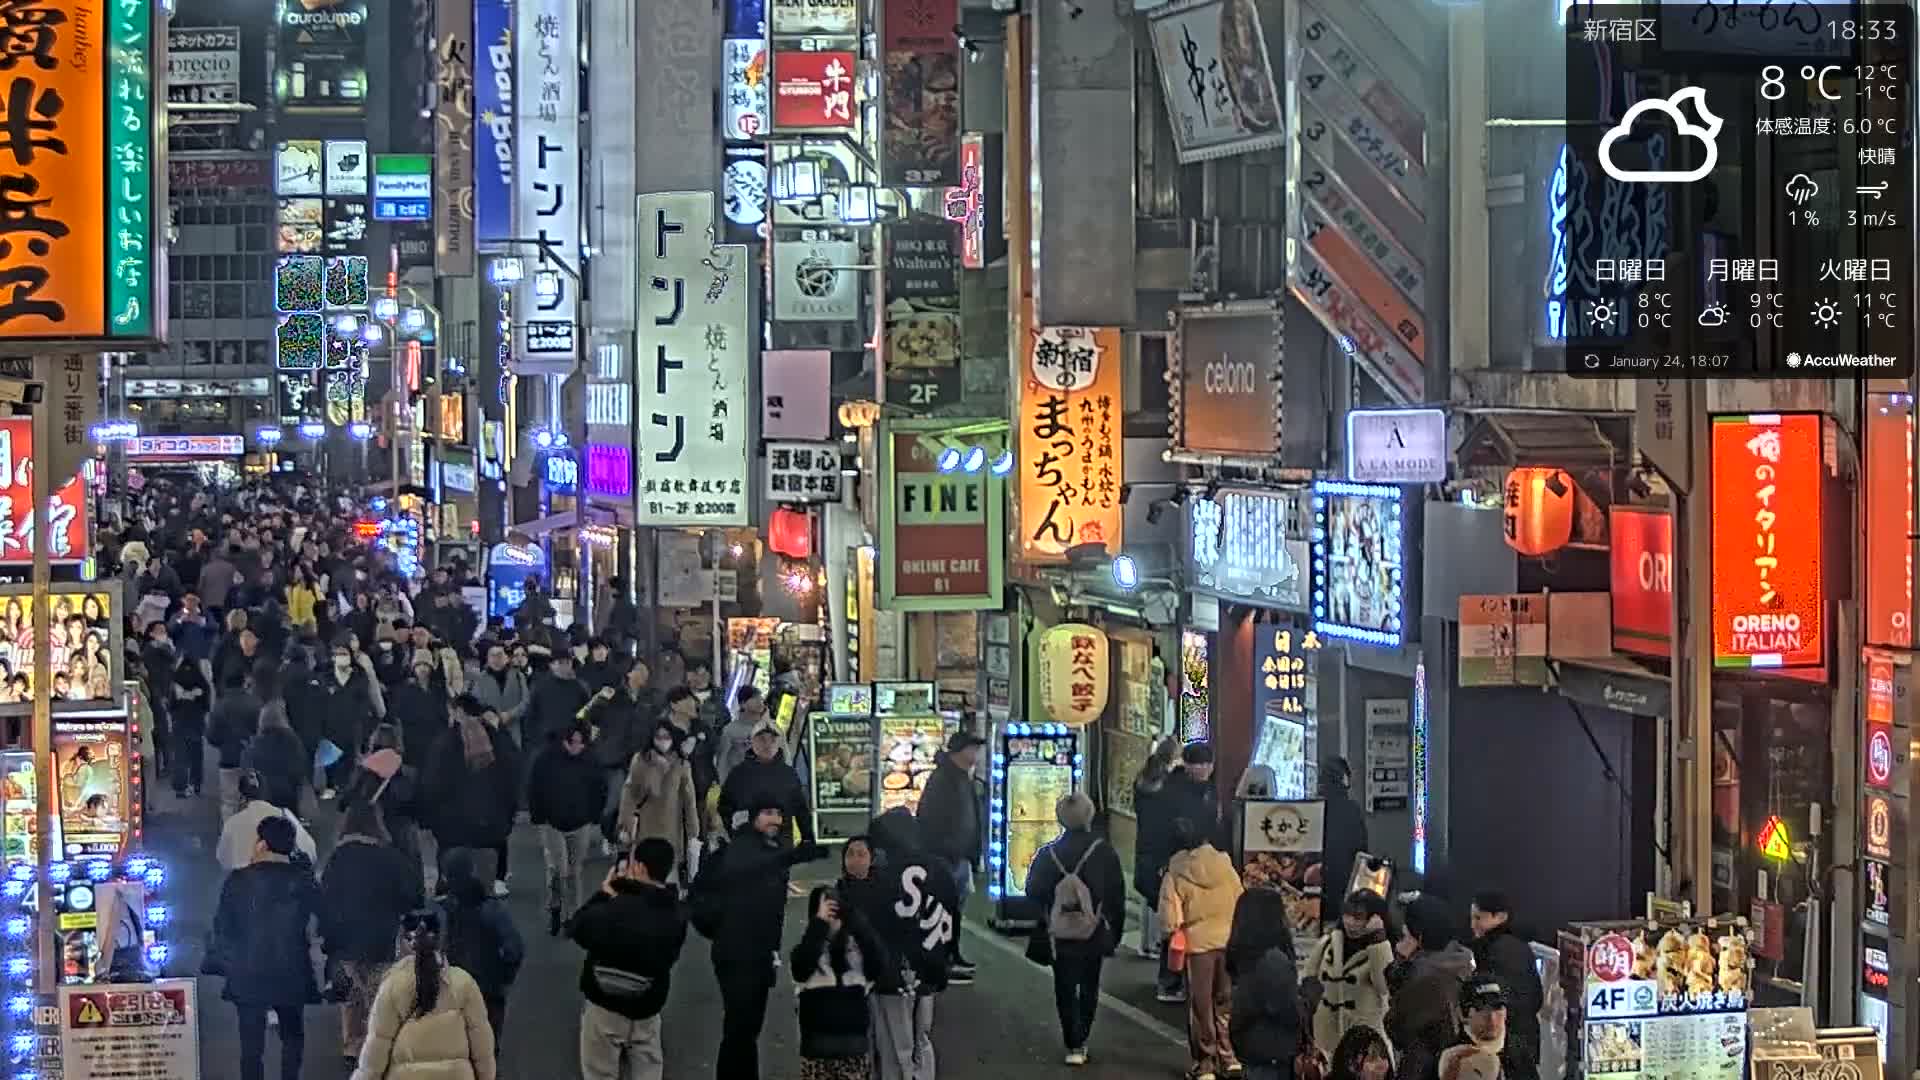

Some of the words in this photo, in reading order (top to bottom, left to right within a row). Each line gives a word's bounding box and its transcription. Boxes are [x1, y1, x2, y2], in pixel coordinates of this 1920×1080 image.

[287, 11, 361, 25] auralume
[1306, 21, 1327, 41] 5
[822, 57, 851, 120] 牛門
[1305, 73, 1325, 91] 4
[1306, 122, 1327, 142] 3
[378, 181, 428, 192] FamilyMart
[1305, 173, 1325, 189] 2
[650, 208, 685, 462] トントン
[1204, 351, 1256, 393] celona
[63, 353, 85, 444] 通り一番街
[909, 384, 939, 404] 2F
[772, 448, 836, 471] 酒場心
[1033, 395, 1077, 543] まっちゃん
[771, 473, 836, 492] 新宿本店
[903, 484, 978, 513] FINE
[1746, 430, 1781, 605] 俺のイタリアン
[903, 560, 948, 575] ONLINE
[951, 559, 981, 574] CAFE
[1732, 613, 1801, 632] ORENO
[1731, 633, 1801, 649] ITALIAN
[818, 782, 841, 796] 2F
[1591, 988, 1625, 1010] 4F
